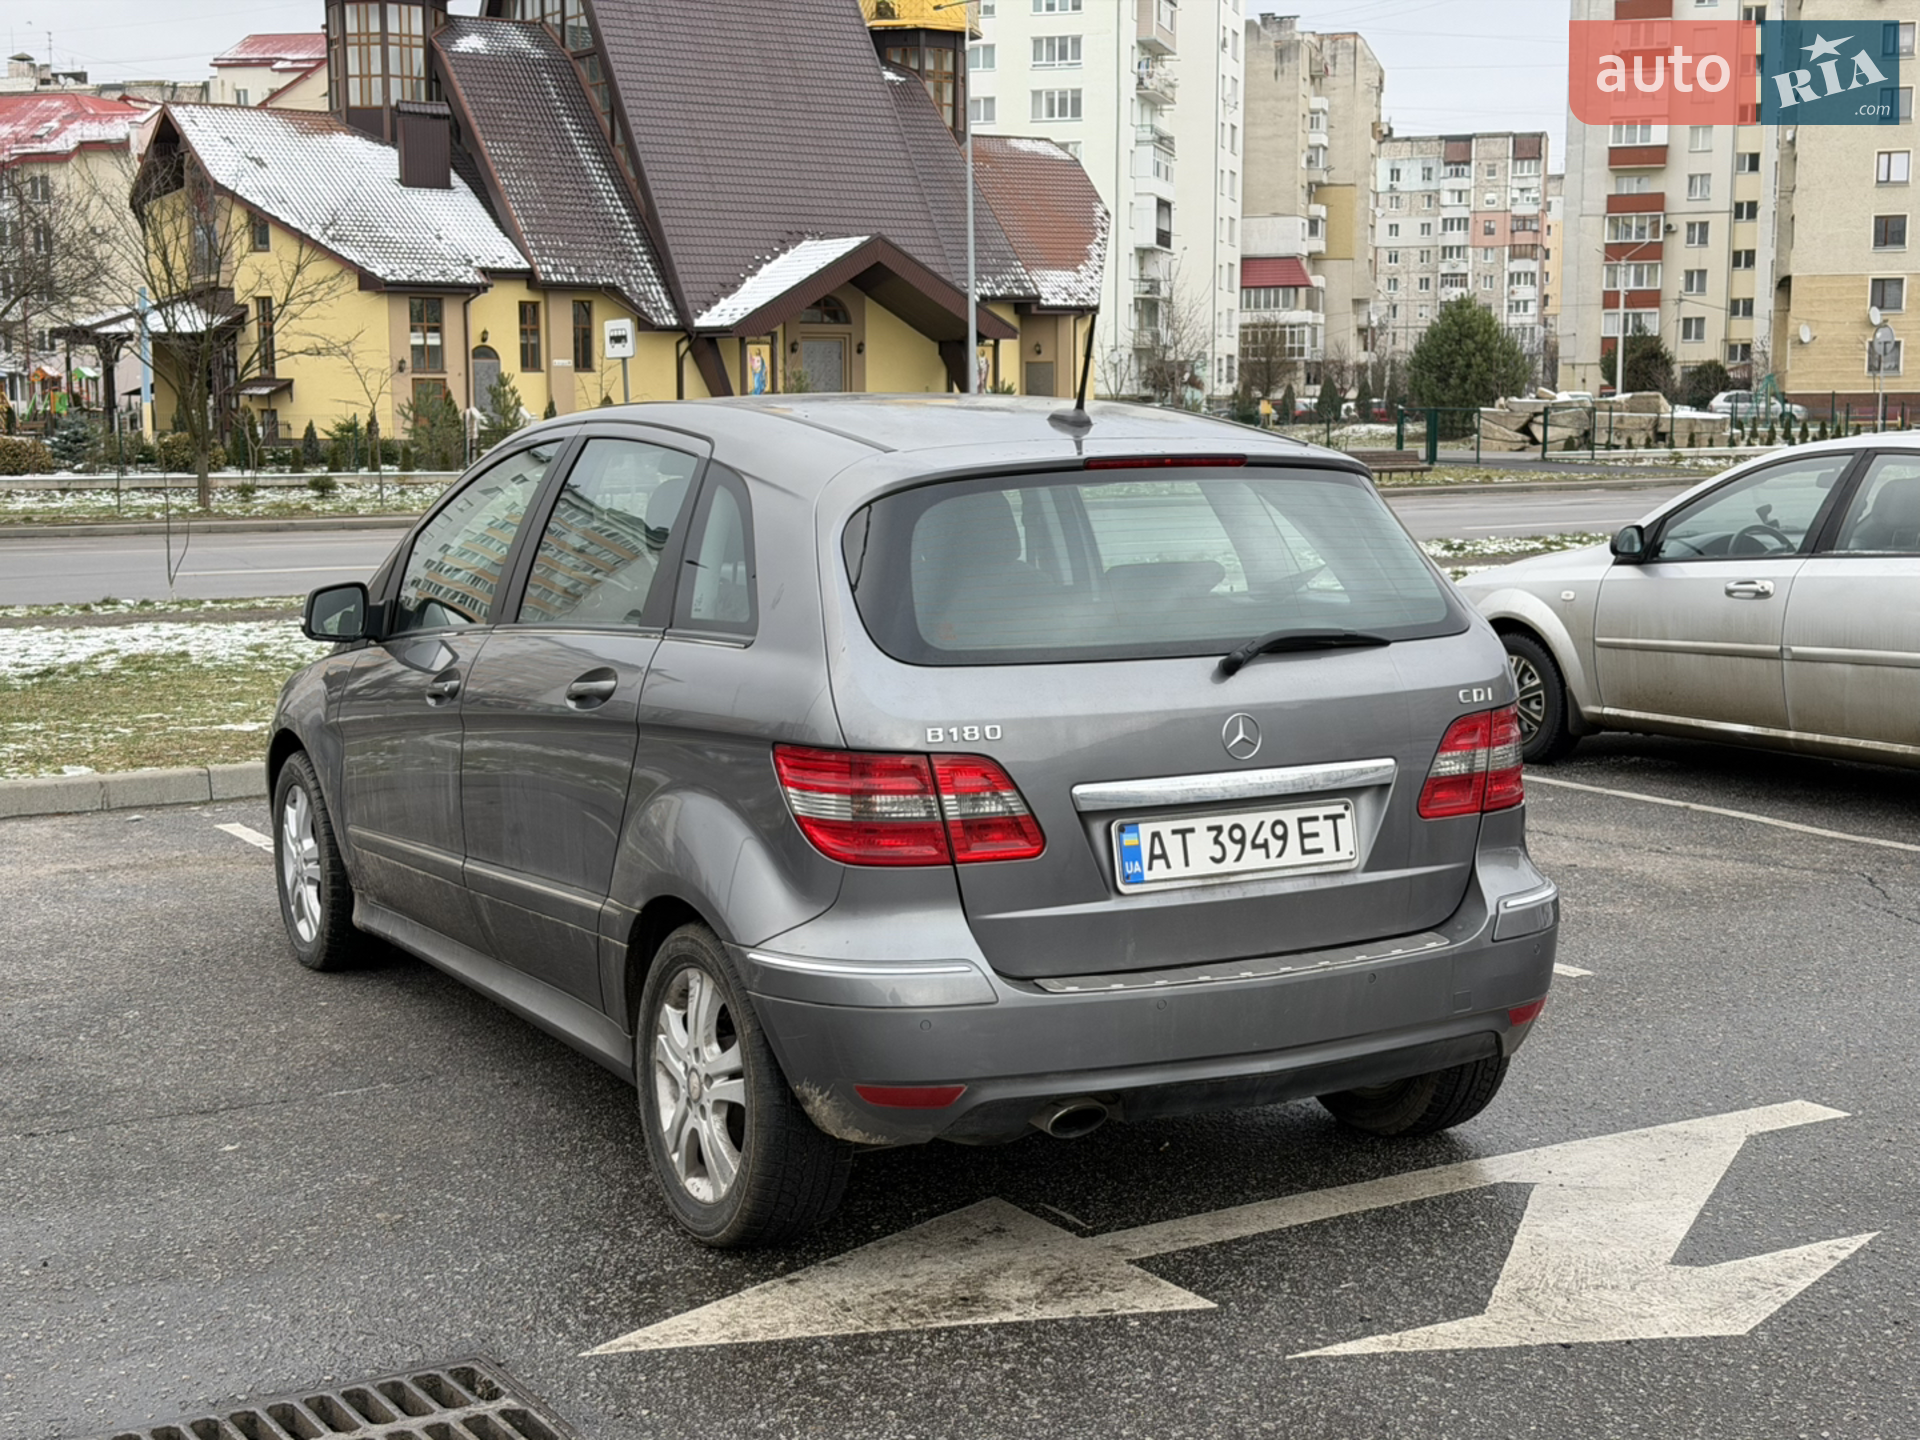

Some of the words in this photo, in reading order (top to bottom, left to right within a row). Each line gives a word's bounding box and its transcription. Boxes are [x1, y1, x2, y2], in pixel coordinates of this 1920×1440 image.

[1458, 687, 1493, 704] CDI
[926, 724, 1002, 743] B180
[1147, 827, 1196, 872] AT
[1206, 818, 1289, 865] 3949
[1297, 813, 1346, 856] ET
[1124, 860, 1142, 875] UA
